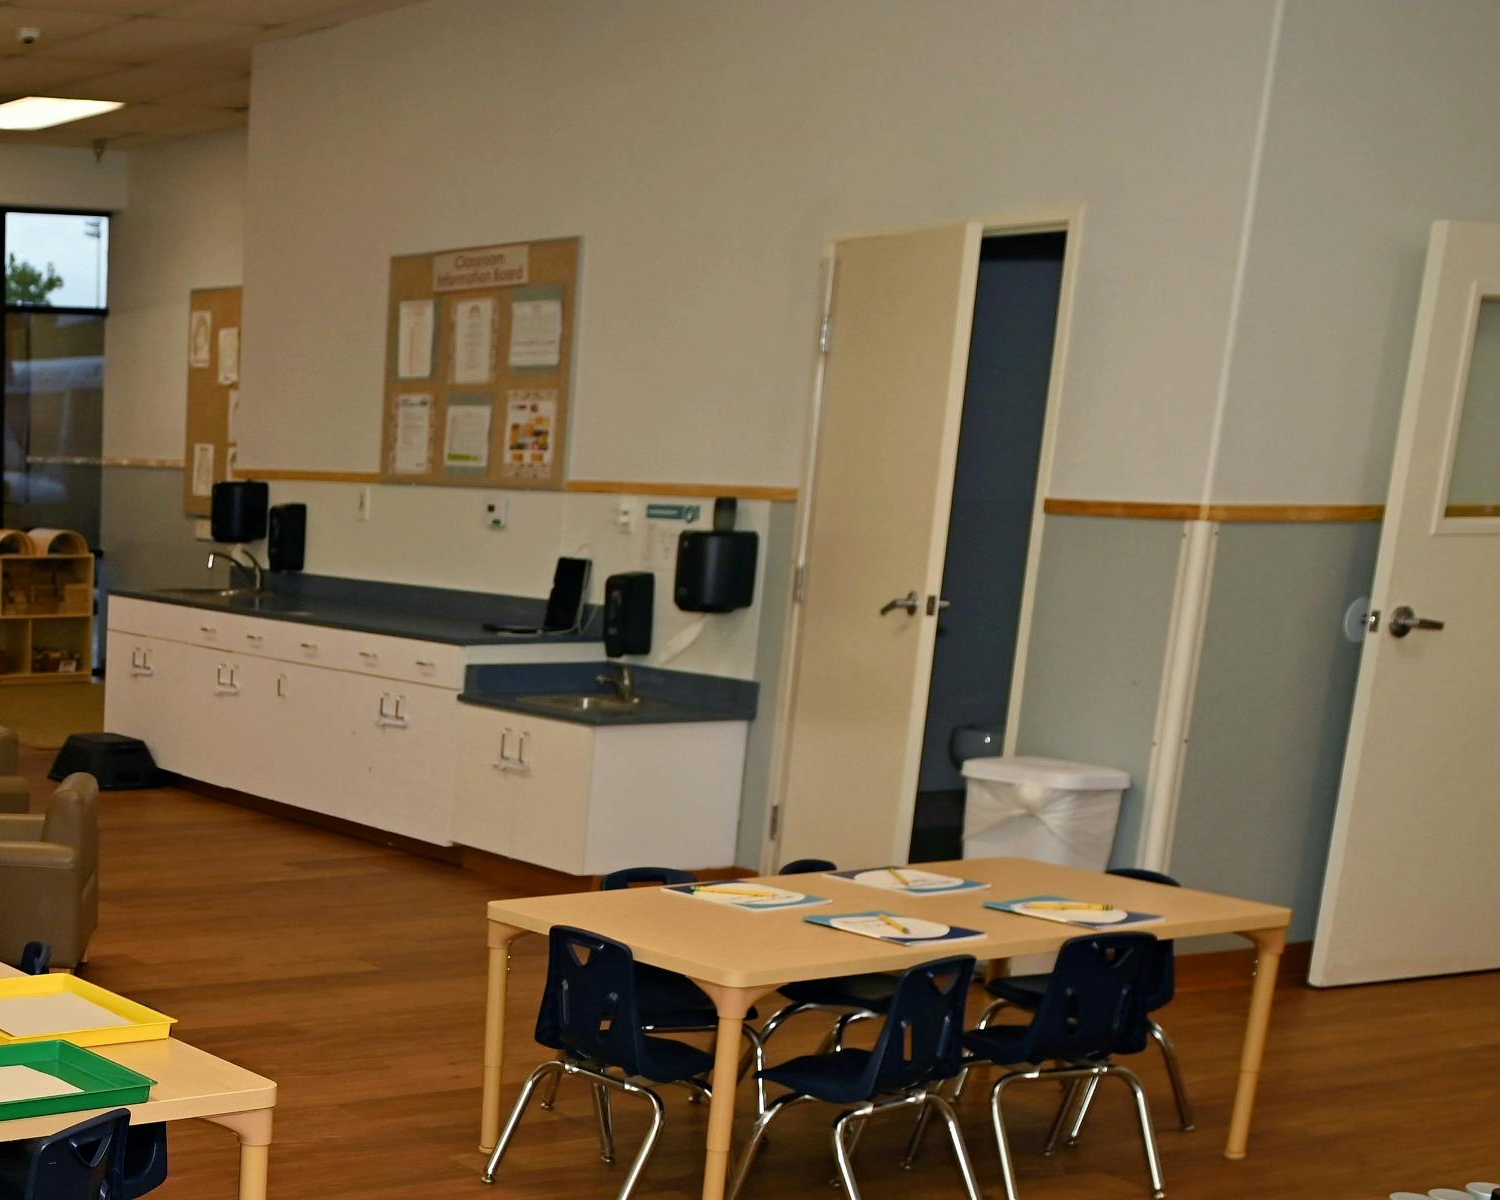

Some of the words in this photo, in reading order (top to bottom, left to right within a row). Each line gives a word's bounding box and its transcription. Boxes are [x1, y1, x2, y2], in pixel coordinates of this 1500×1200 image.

[454, 252, 506, 268] Classroom
[437, 270, 491, 287] Information
[493, 267, 524, 282] Board
